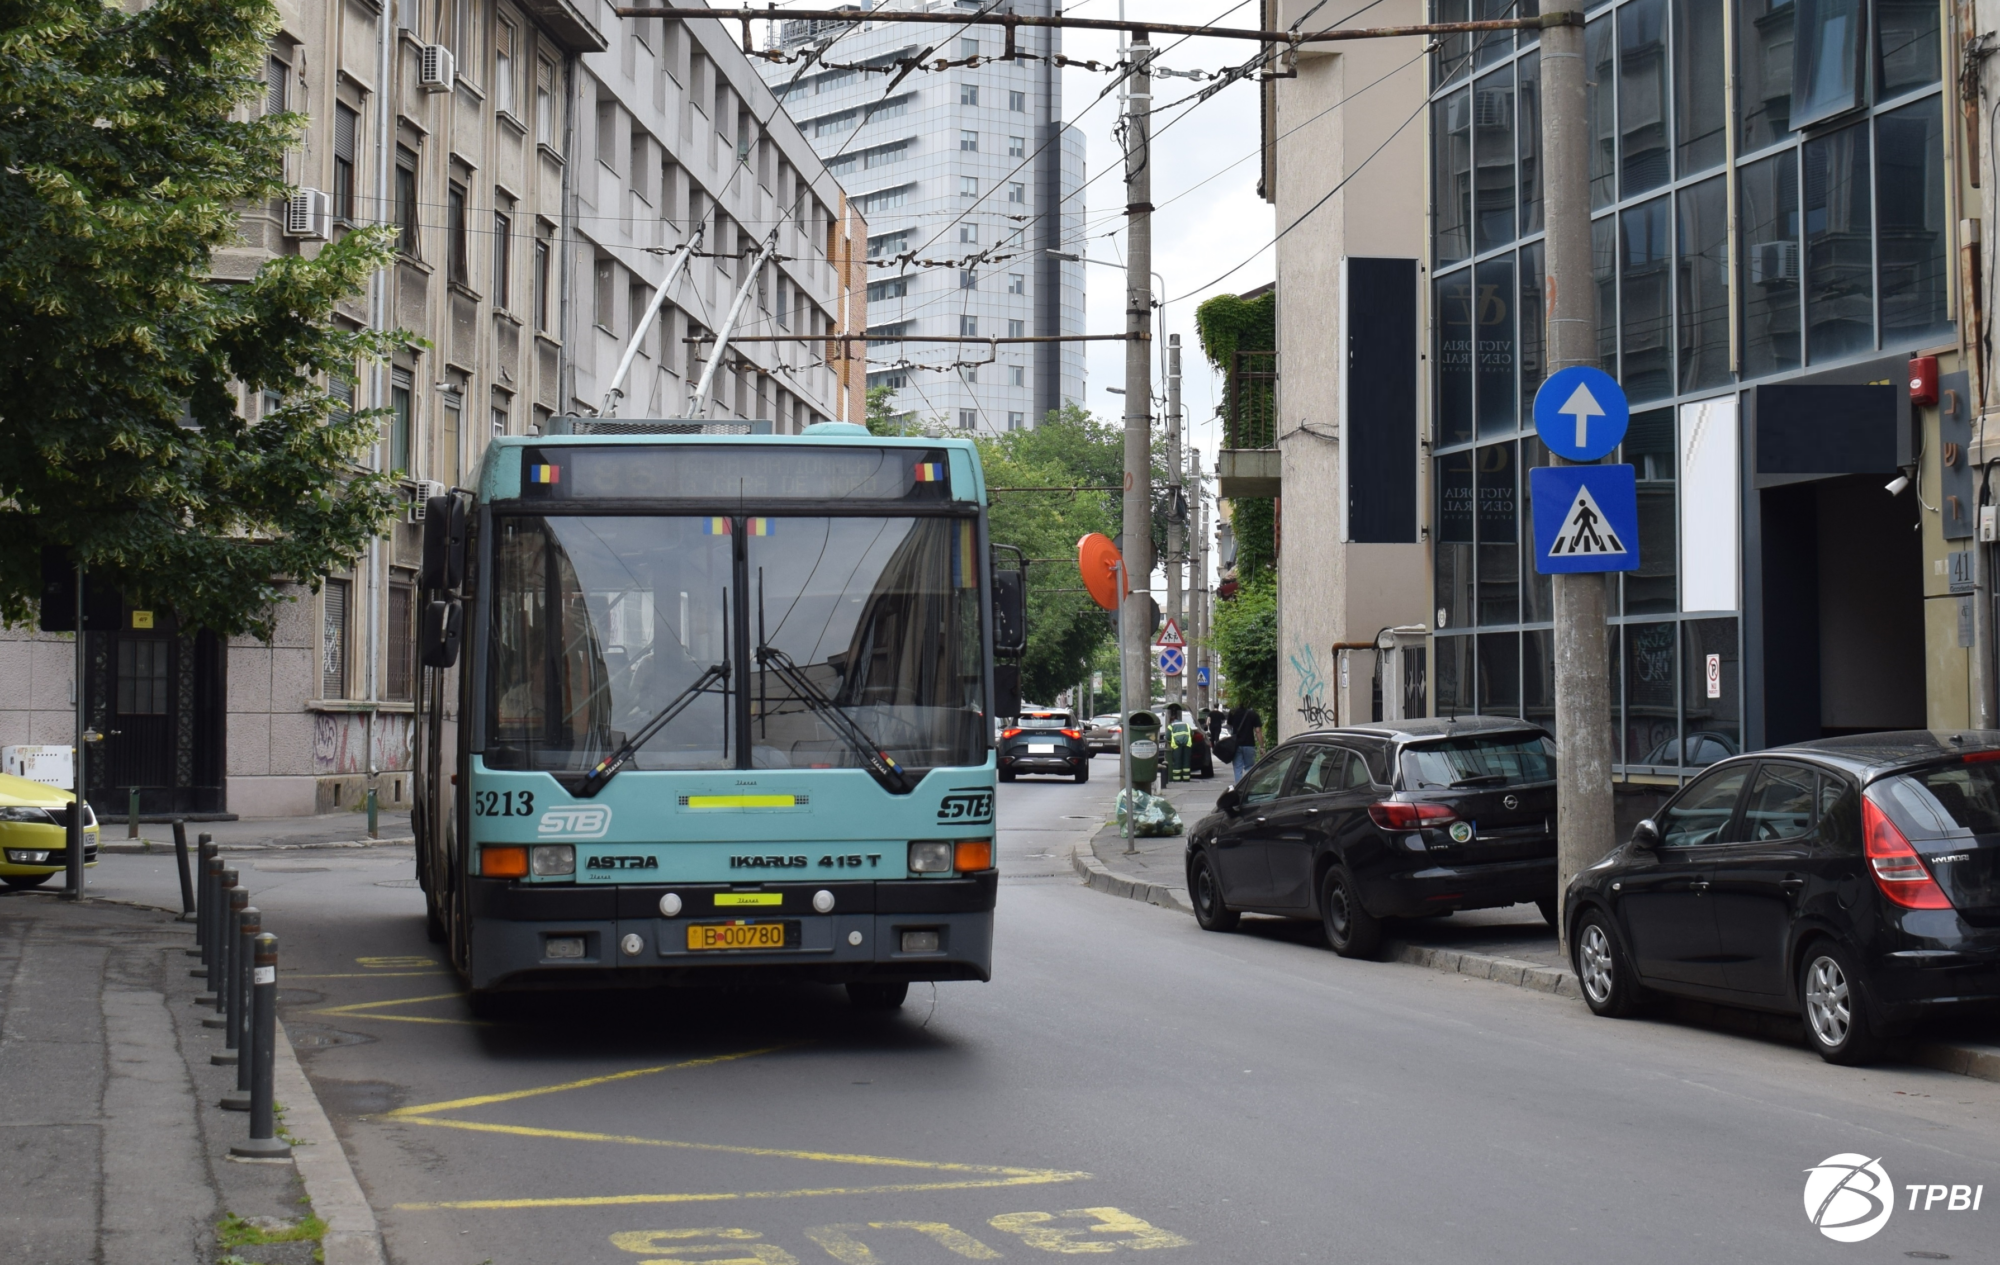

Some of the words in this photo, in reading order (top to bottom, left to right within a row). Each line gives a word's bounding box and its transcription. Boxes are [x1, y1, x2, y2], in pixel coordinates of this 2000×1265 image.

[1954, 552, 1970, 581] 41
[475, 790, 534, 817] 5213
[937, 793, 993, 819] STB
[538, 809, 605, 834] STB
[586, 856, 659, 869] ASTRA
[730, 855, 808, 868] IKARUS
[818, 854, 862, 867] 415
[867, 854, 881, 867] T
